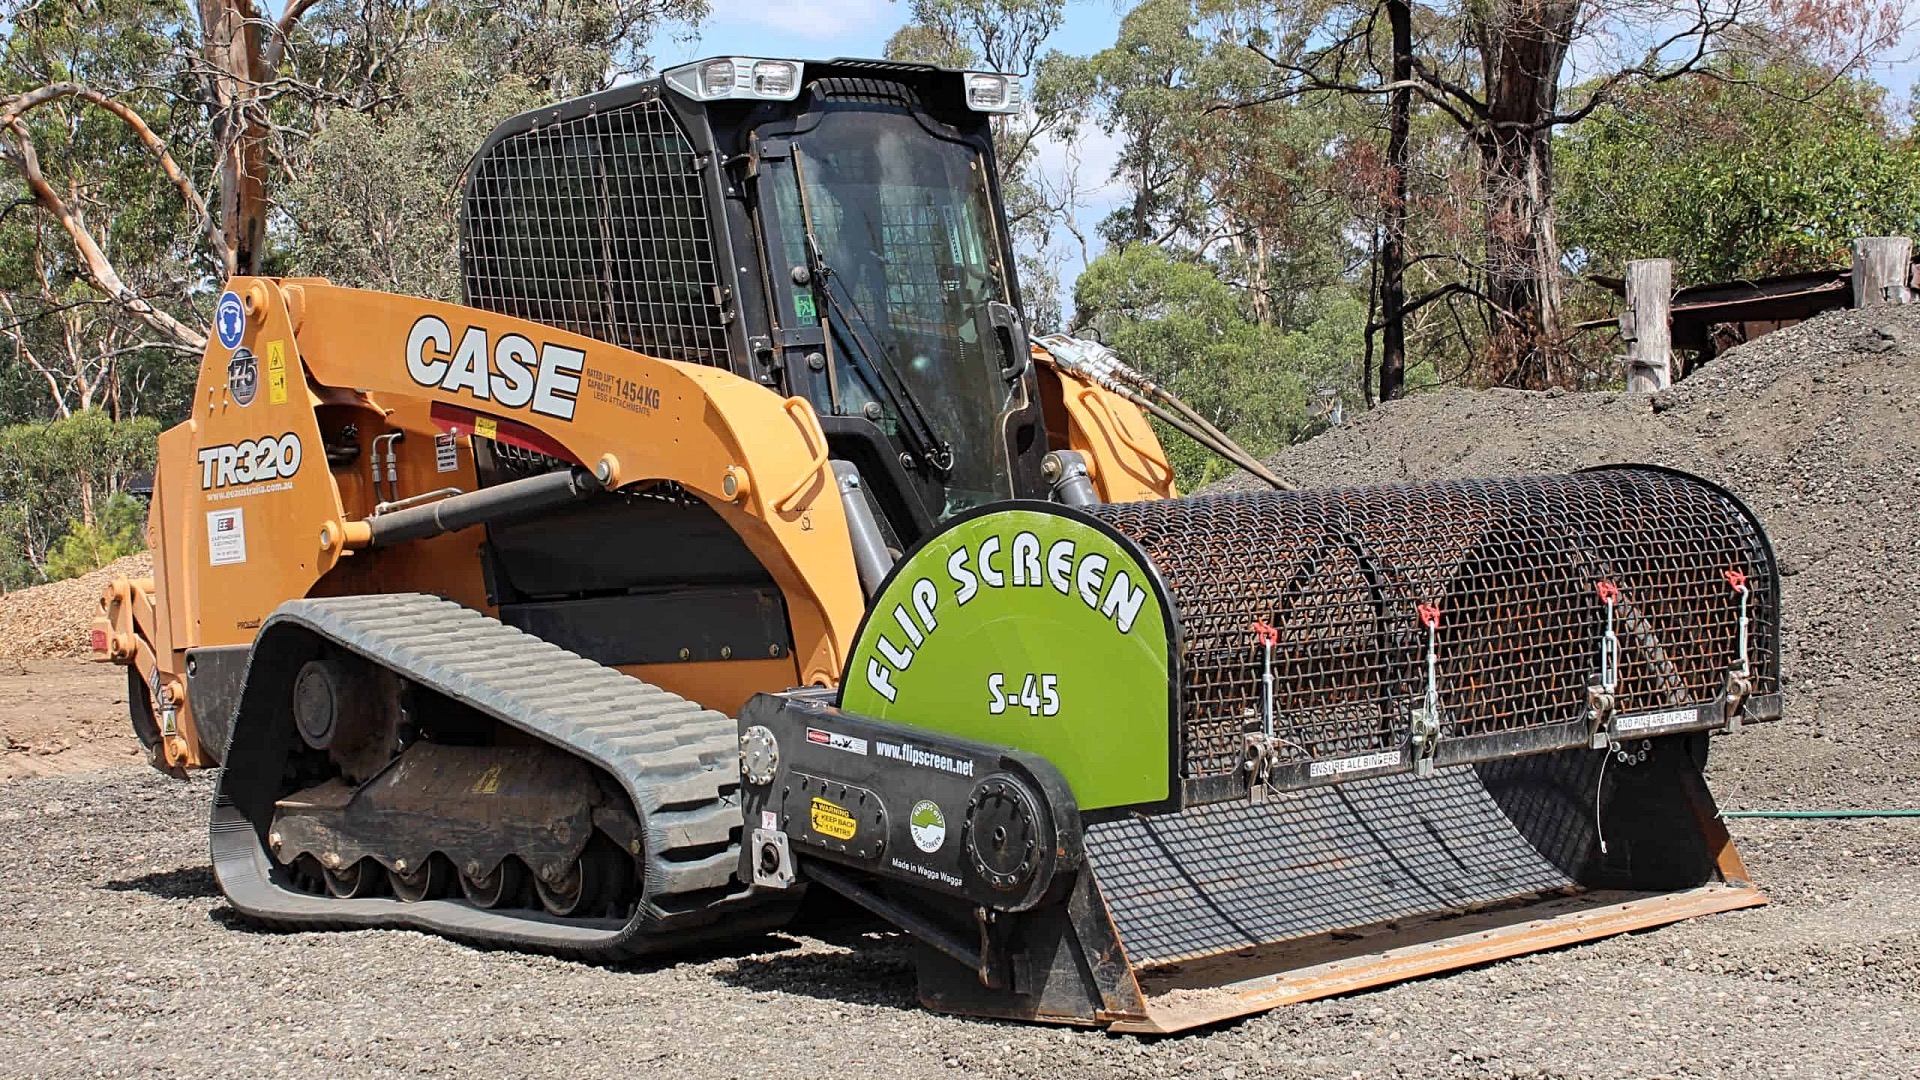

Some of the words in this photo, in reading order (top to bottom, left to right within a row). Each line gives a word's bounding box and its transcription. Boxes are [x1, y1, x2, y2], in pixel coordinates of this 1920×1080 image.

[406, 315, 586, 421] CASE
[587, 368, 603, 381] RATED
[604, 371, 615, 384] LIFT
[588, 379, 612, 393] CAPACITY
[616, 378, 660, 410] 1454KG
[594, 391, 608, 403] LESS
[609, 396, 650, 415] ATTACHMENTS
[198, 432, 302, 490] TR320
[867, 578, 938, 703] FLIP
[947, 530, 1147, 634] SCREEN
[987, 673, 1060, 716] S-45
[876, 741, 974, 777] www.flipscreen.net
[819, 803, 849, 817] WARNING
[821, 814, 837, 824] KEEP
[838, 818, 855, 828] BACK
[892, 857, 909, 870] Made
[910, 862, 917, 872] in
[917, 864, 939, 880] Wagga
[940, 871, 962, 887] Wagga
